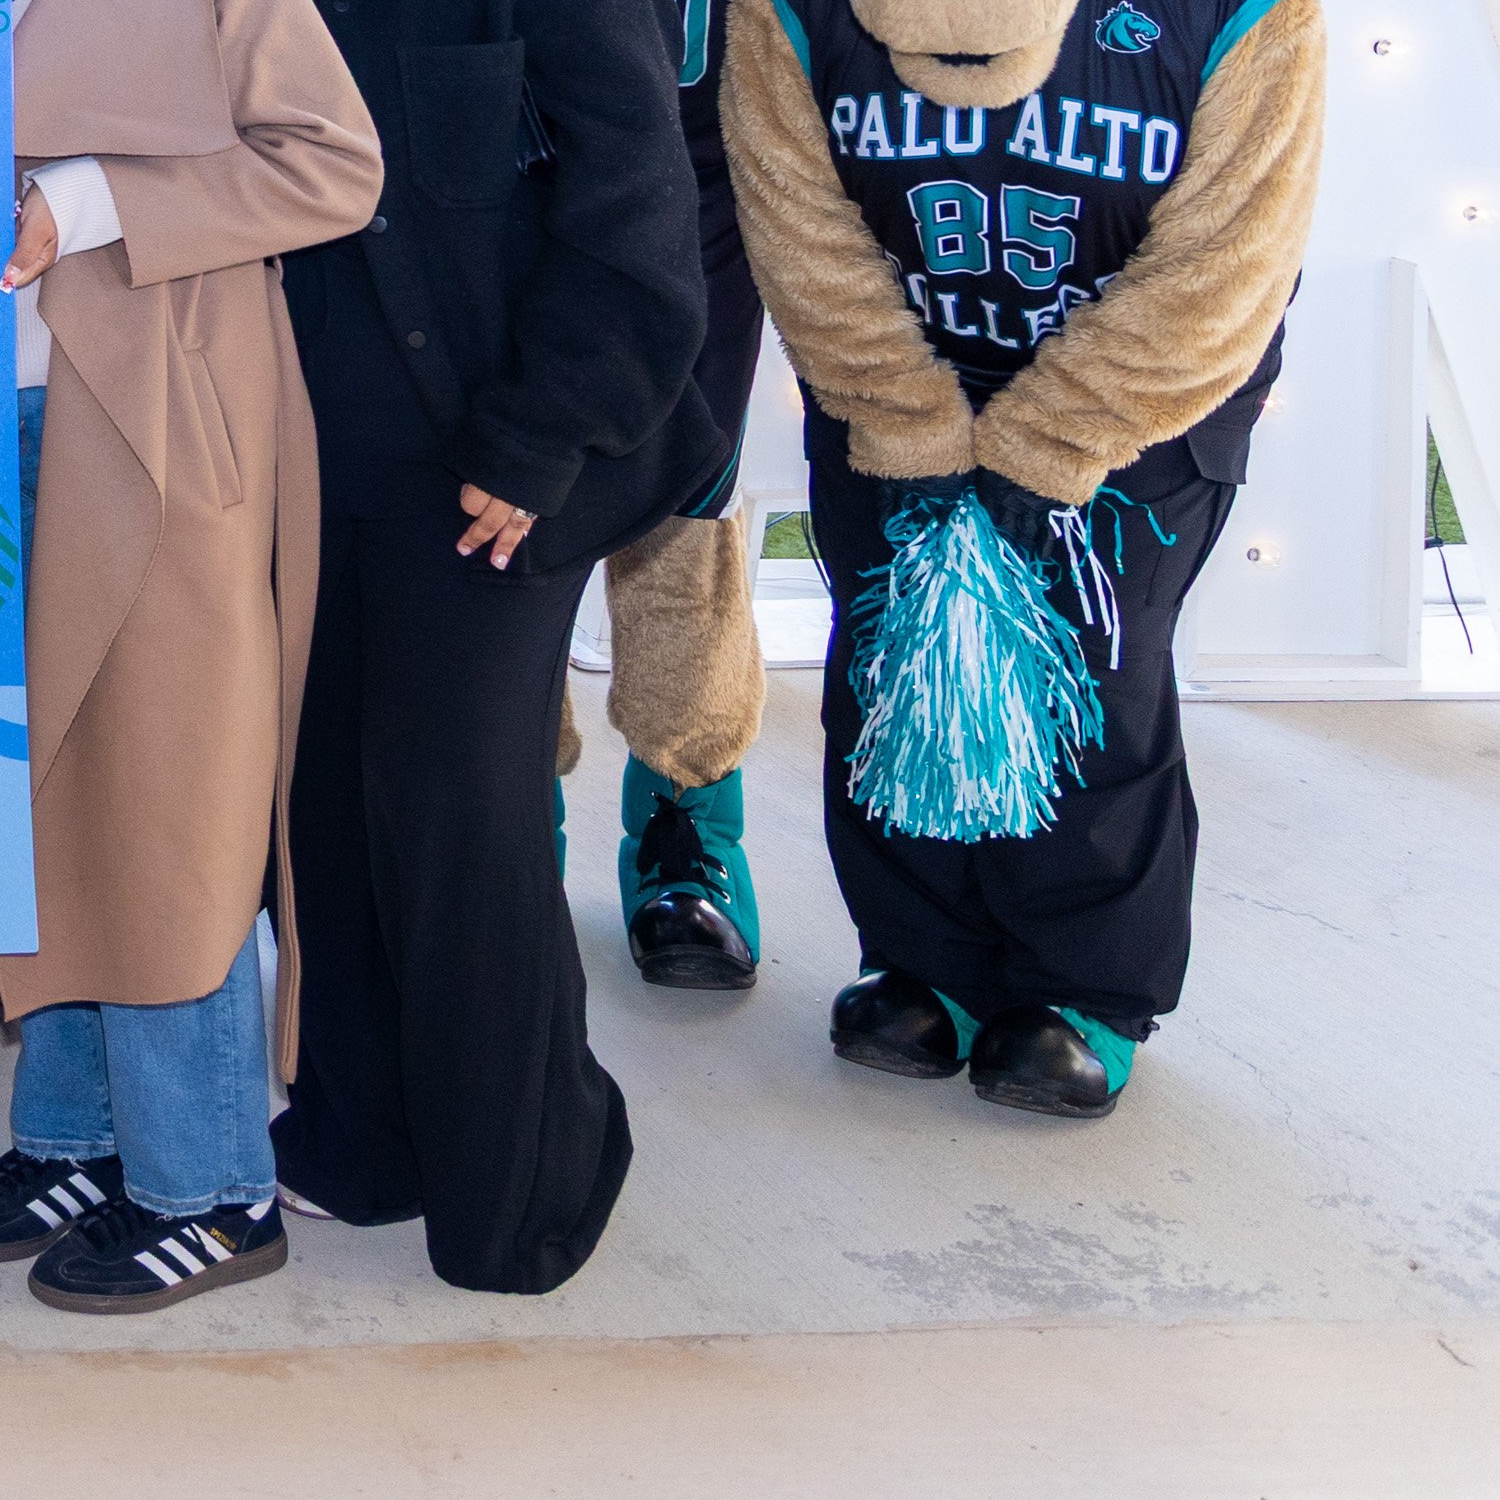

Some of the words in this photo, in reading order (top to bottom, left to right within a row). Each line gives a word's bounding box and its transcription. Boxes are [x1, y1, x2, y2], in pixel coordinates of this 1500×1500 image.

[831, 91, 988, 160] PALO
[1006, 91, 1181, 184] ALTO
[906, 179, 1081, 291] 85
